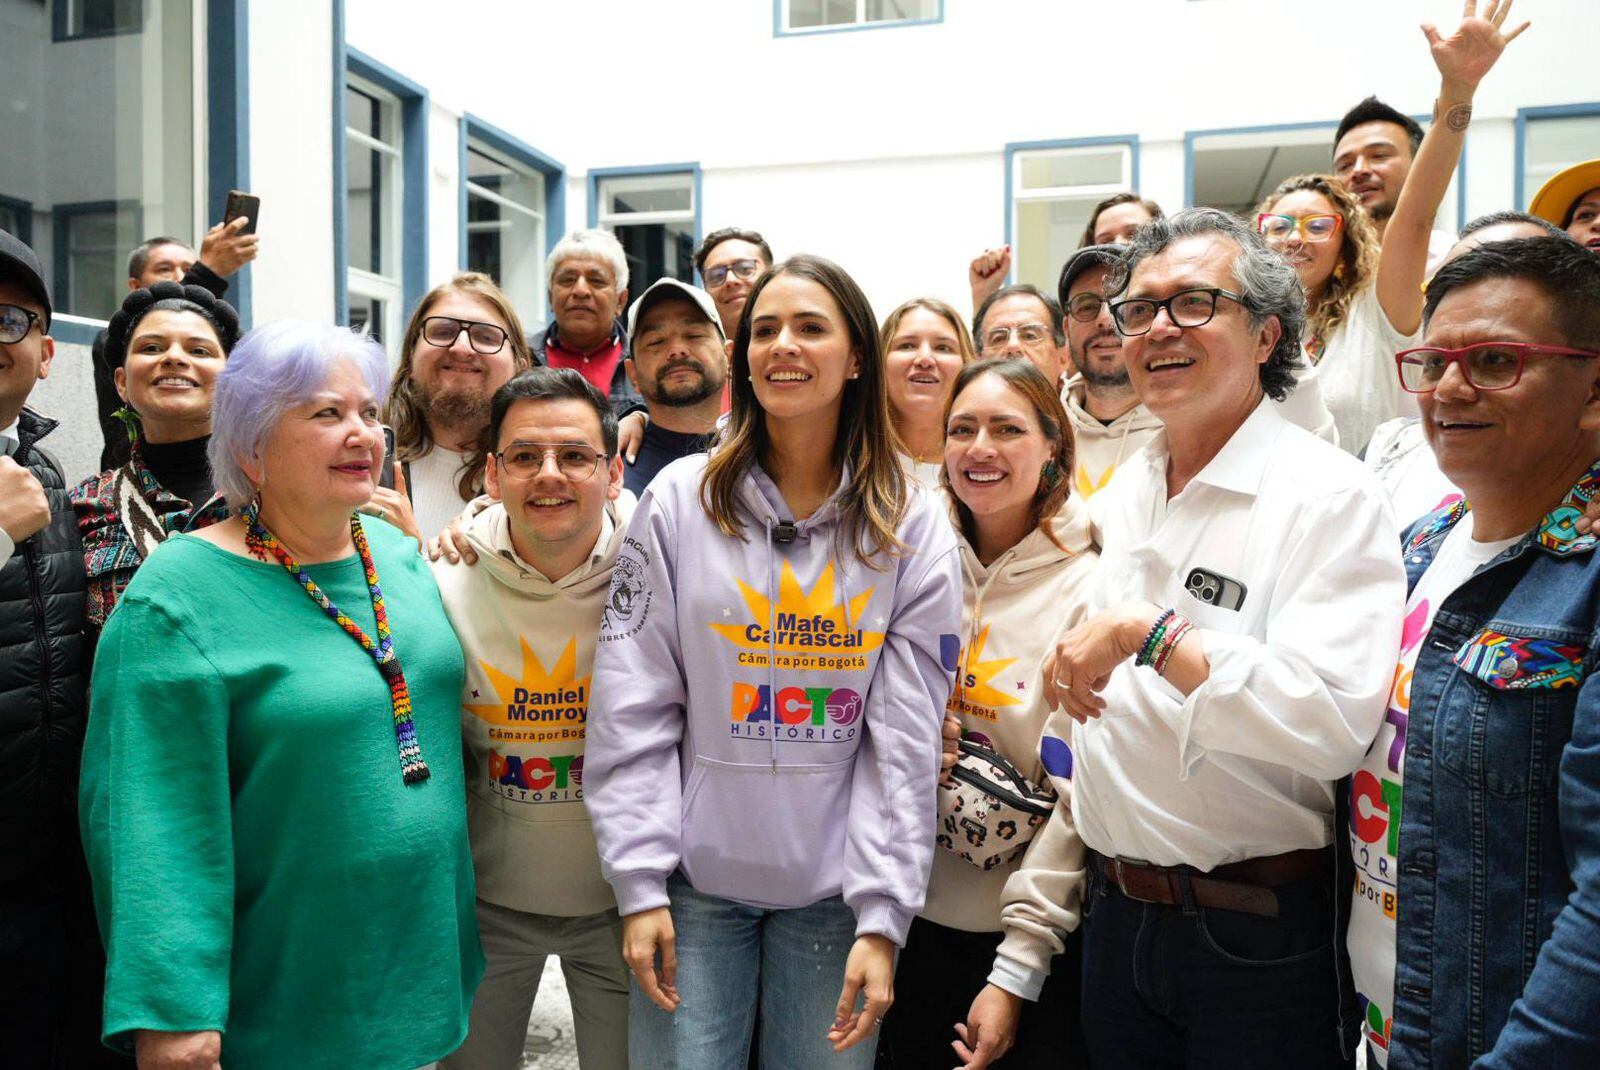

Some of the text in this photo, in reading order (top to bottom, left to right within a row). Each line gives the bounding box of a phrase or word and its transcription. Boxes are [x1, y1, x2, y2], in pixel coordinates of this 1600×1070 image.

[777, 612, 836, 633] Mafe
[745, 623, 864, 648] Carrascal
[738, 652, 866, 670] Cámra por Bogotá
[513, 686, 584, 705] Daniel
[731, 682, 862, 726] PACTO
[507, 704, 588, 723] Monroy
[488, 728, 536, 740] Cámara
[537, 731, 559, 742] por
[731, 725, 856, 740] HISTÓRICO
